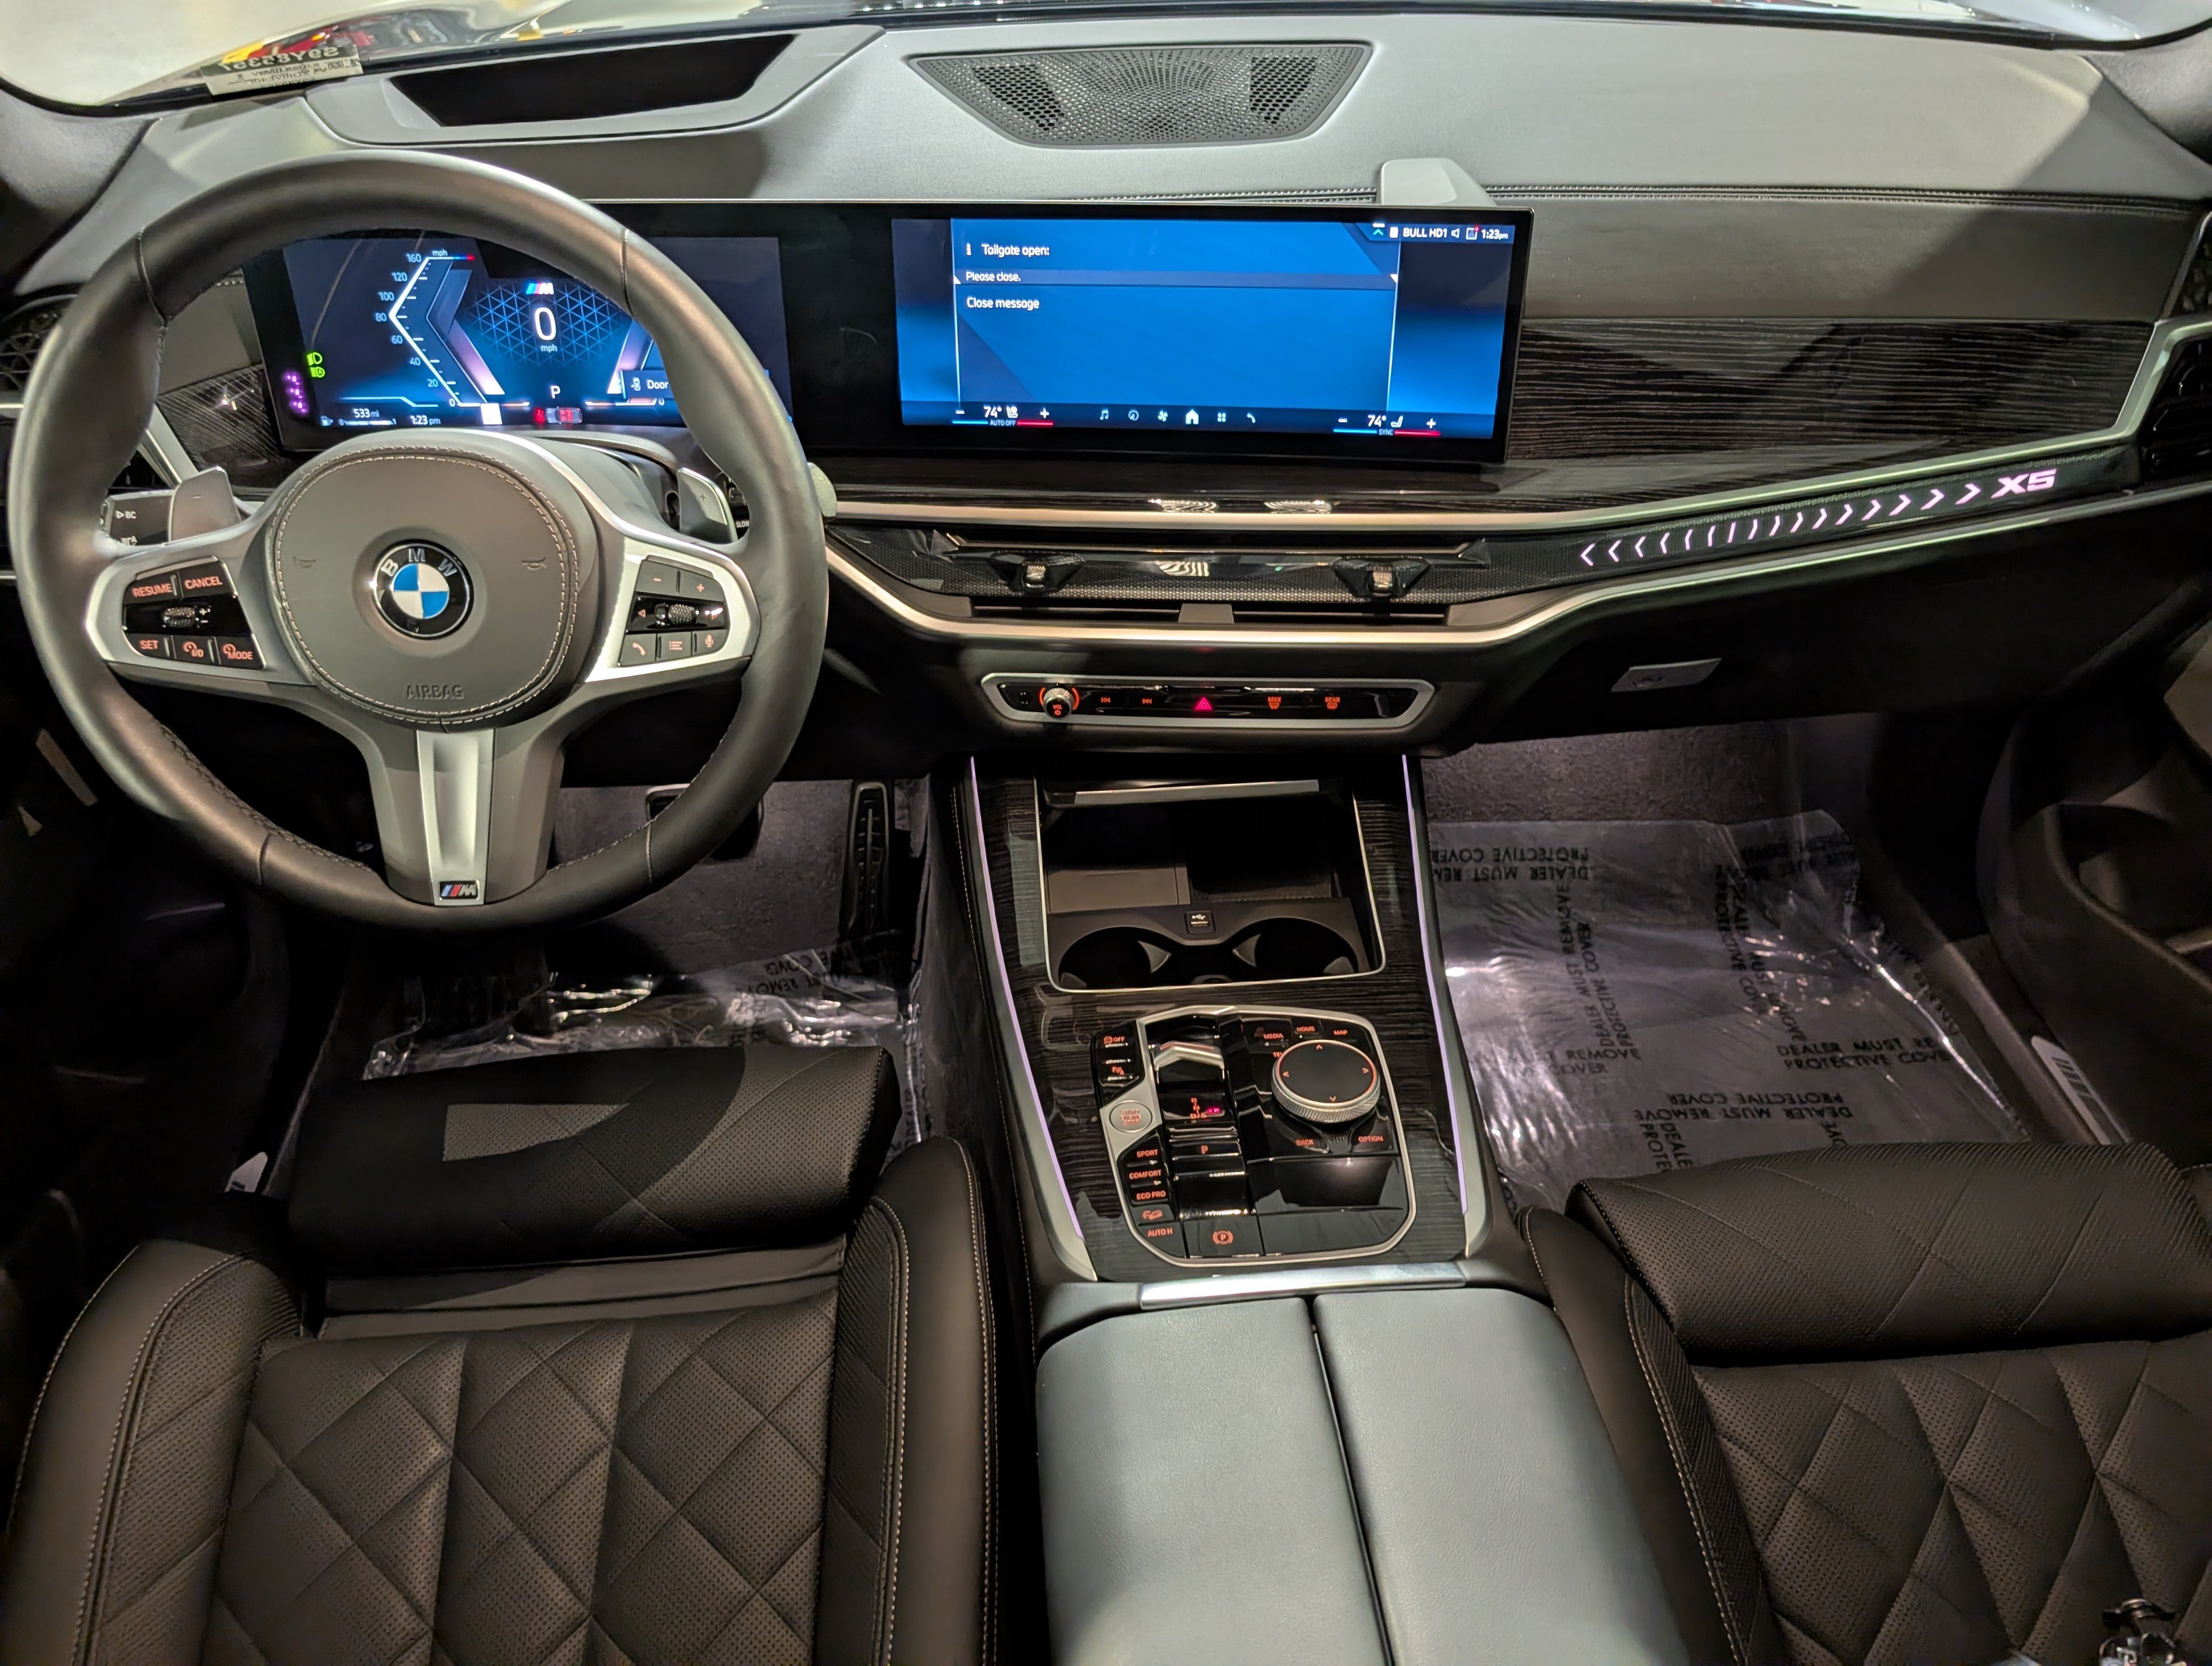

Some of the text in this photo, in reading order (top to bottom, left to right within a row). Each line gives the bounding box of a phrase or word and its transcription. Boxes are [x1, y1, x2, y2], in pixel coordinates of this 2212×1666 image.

[1403, 228, 1447, 238] BULL HD1
[432, 249, 448, 258] mph
[982, 244, 1020, 258] Tailgate
[1023, 246, 1050, 258] open:
[406, 254, 422, 263] 160
[393, 272, 407, 282] 120
[966, 271, 1021, 283] Please close.
[379, 291, 394, 302] 100
[967, 298, 1040, 311] Close message
[375, 313, 387, 322] 80
[534, 306, 557, 341] 0
[391, 335, 403, 344] 60
[541, 344, 558, 354] mph
[410, 357, 421, 366] 40
[427, 379, 439, 388] 20
[647, 380, 668, 389] Door
[550, 386, 561, 400] P
[449, 399, 456, 408] 0
[353, 408, 380, 418] 533 mi
[410, 415, 428, 425] 1:23
[1991, 469, 2057, 499] X5
[381, 548, 457, 577] BMW
[184, 576, 223, 589] CANCEL
[132, 583, 173, 598] RESUME
[139, 640, 159, 650] SET
[227, 651, 253, 660] MODE
[407, 684, 464, 700] AIRBAG
[1474, 867, 1518, 882] MUST
[1566, 1048, 1642, 1061] REMOVE
[1666, 1093, 1728, 1105] COVER
[1633, 1106, 1853, 1122] DEALER MUST REMOVE
[1136, 1149, 1158, 1158] SPORT
[1129, 1169, 1162, 1180] COMFORT
[1136, 1190, 1166, 1200] ECO PRO
[1147, 1228, 1166, 1238] AUTO
